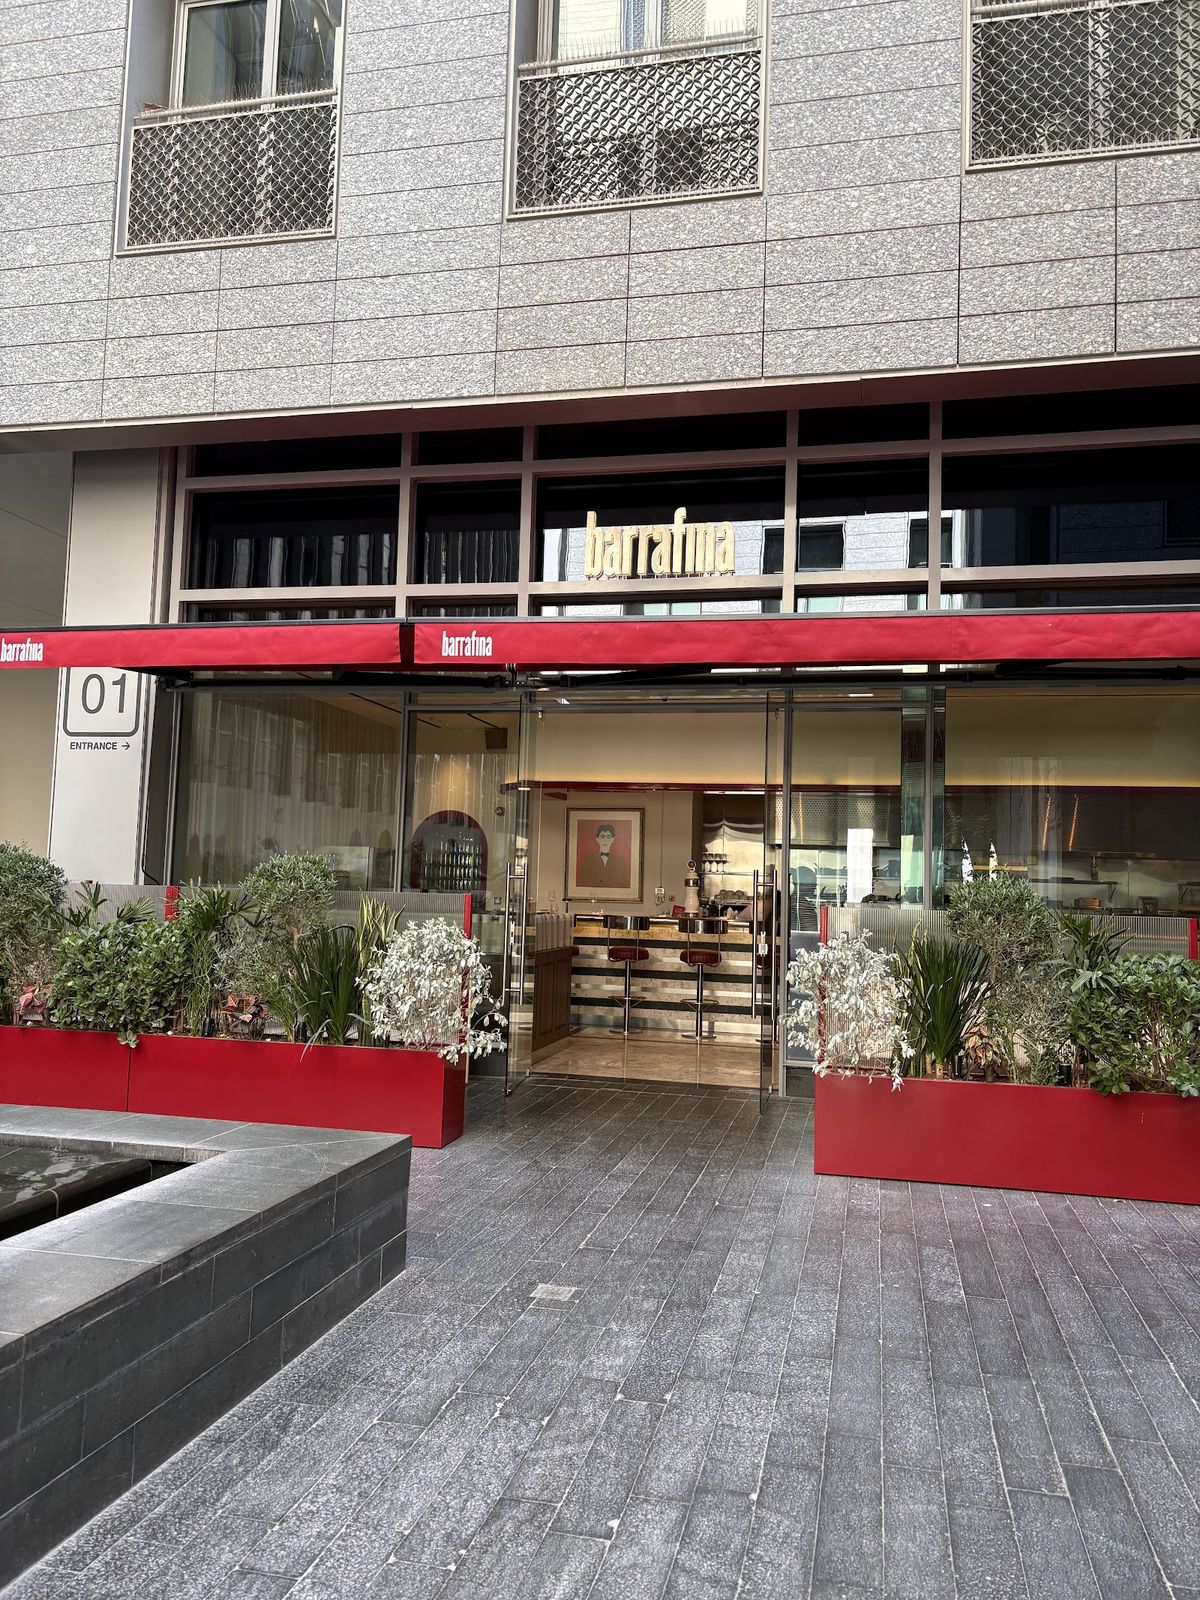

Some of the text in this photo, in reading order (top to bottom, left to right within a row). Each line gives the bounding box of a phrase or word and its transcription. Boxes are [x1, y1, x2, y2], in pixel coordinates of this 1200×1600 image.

[584, 507, 736, 578] barrafina
[0, 637, 44, 662] barrafina
[441, 630, 493, 656] barrafina
[82, 673, 126, 714] 01
[69, 741, 118, 751] ENTRANCE
